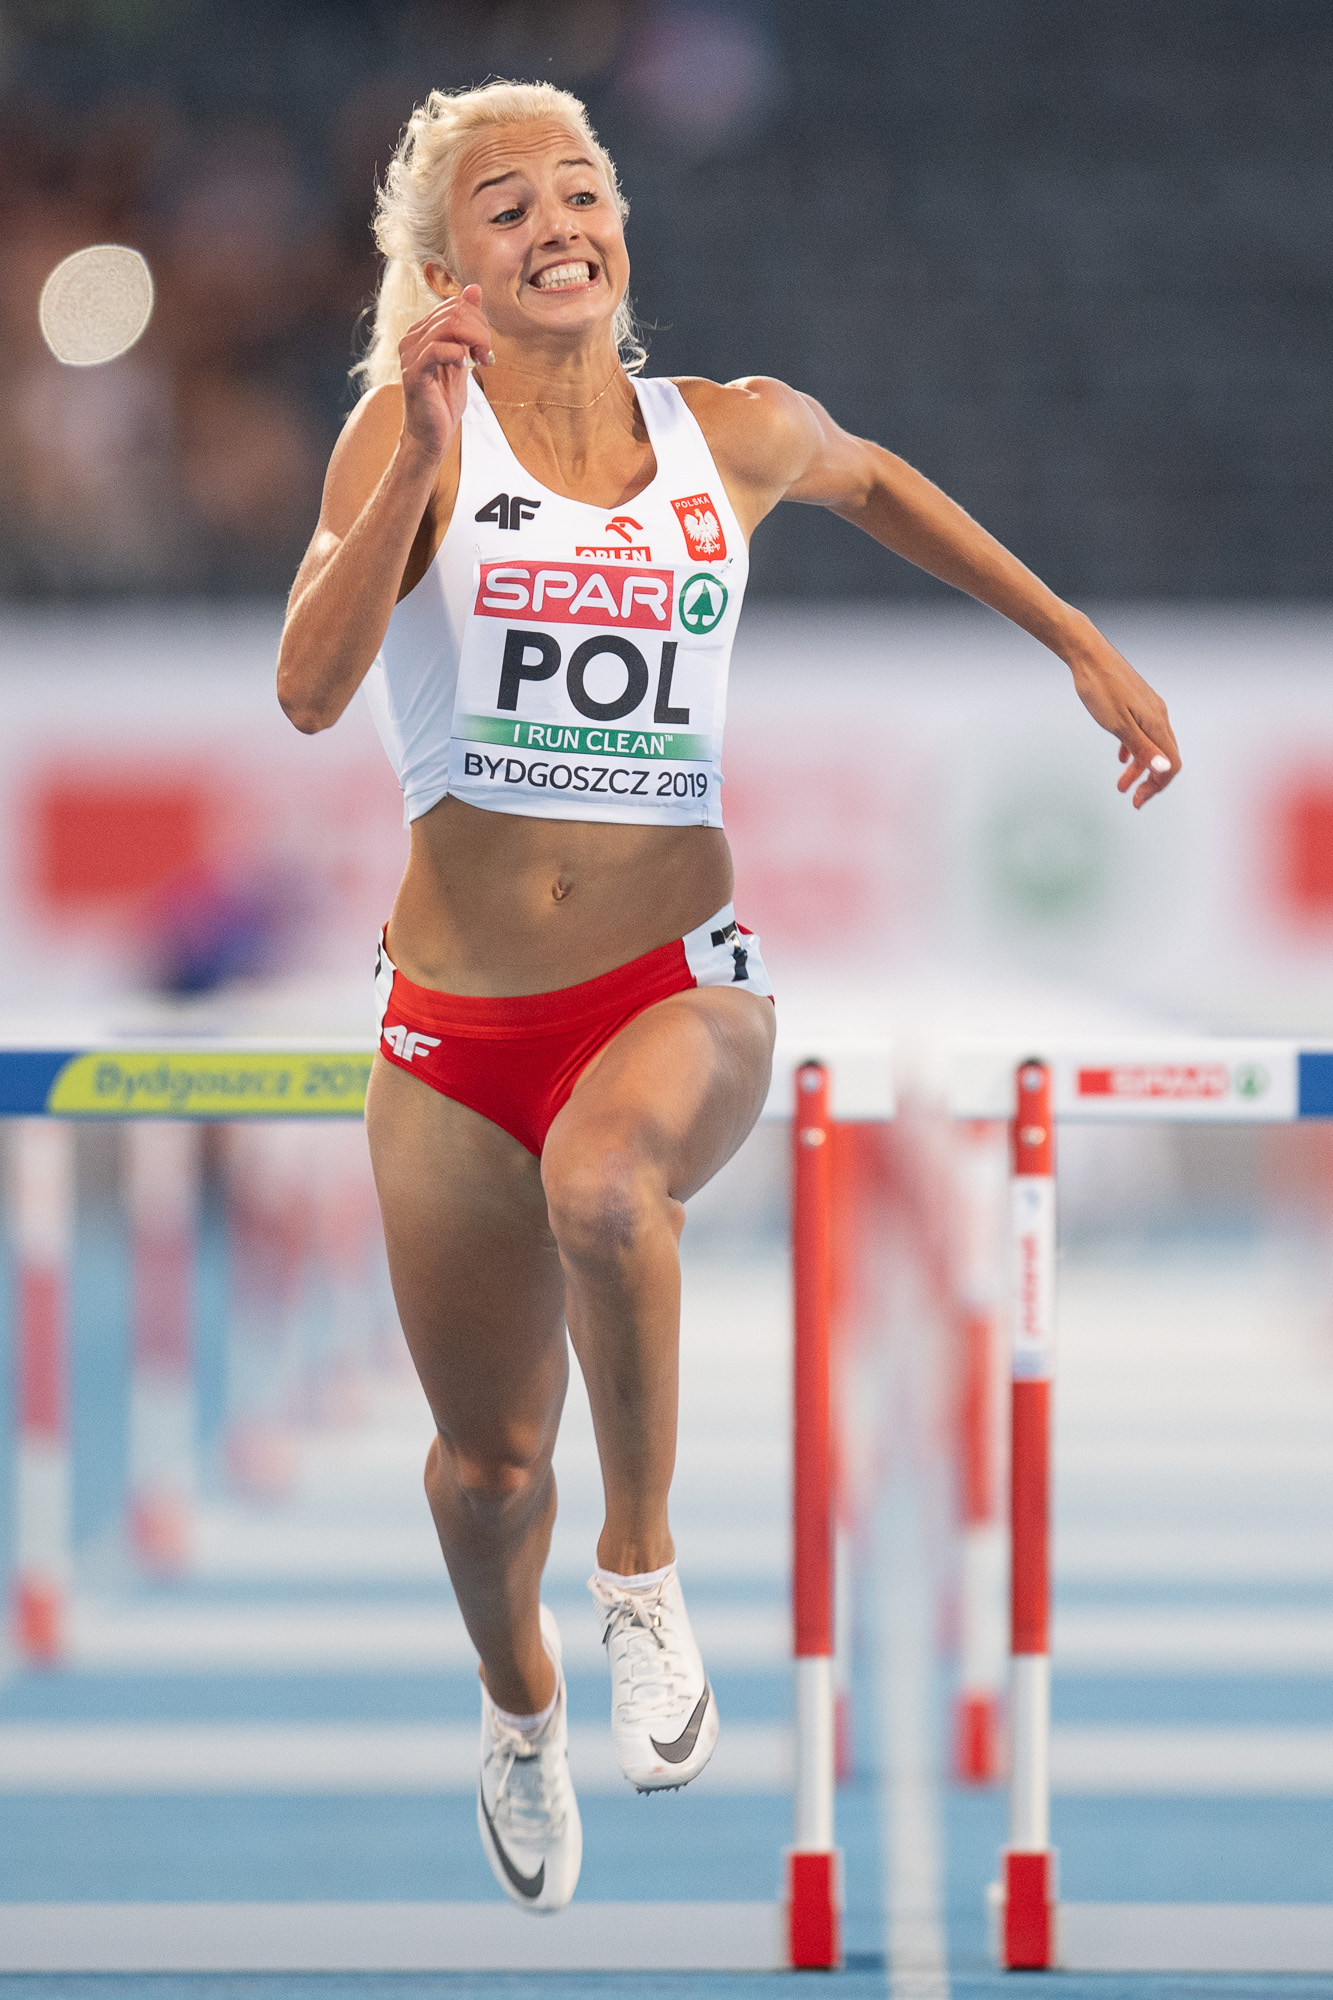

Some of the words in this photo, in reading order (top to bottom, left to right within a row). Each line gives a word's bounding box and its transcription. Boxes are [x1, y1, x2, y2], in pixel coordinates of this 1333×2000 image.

[474, 493, 541, 531] 4F
[674, 496, 710, 509] POLSKA
[482, 568, 667, 621] SPAR
[497, 629, 690, 724] POL
[513, 723, 520, 743] I
[527, 725, 580, 749] RUN
[464, 752, 650, 795] BYDGOSZCZ
[656, 771, 708, 798] 2019
[304, 1062, 371, 1098] 201
